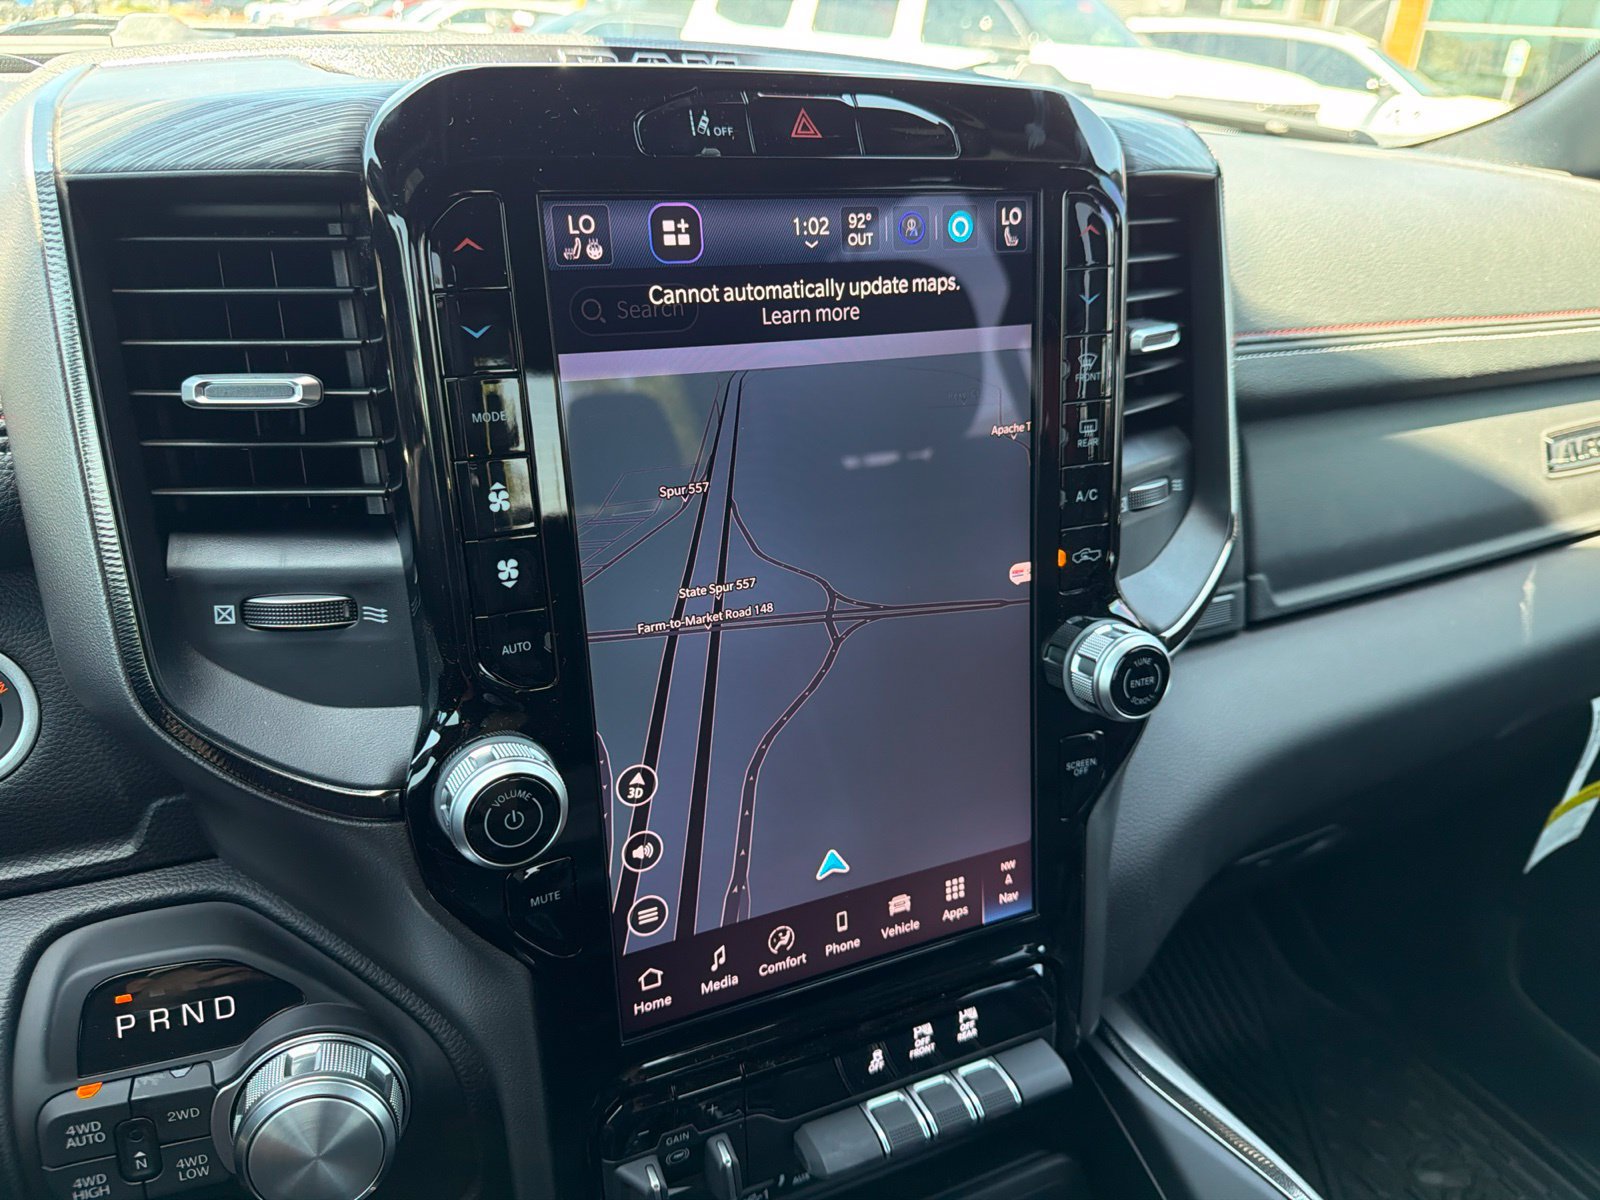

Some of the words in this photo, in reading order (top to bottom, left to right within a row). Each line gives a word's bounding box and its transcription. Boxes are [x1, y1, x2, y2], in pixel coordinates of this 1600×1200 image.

[713, 126, 734, 137] OFF
[567, 214, 595, 234] LO
[848, 212, 872, 229] 92°
[1001, 206, 1023, 226] LO
[793, 216, 830, 236] 1:02
[848, 232, 874, 246] OUT
[648, 284, 720, 305] Cannot
[723, 278, 845, 302] automatically
[849, 276, 909, 299] update
[912, 275, 961, 295] maps.
[617, 300, 684, 320] Search
[762, 307, 811, 325] Learn
[815, 305, 861, 322] more
[471, 411, 508, 423] MODE
[991, 423, 1025, 437] Apache
[1077, 437, 1099, 448] REAR
[659, 484, 687, 499] Spur
[688, 481, 710, 494] 557
[1075, 489, 1098, 502] A/C
[678, 587, 707, 599] State
[709, 582, 734, 596] Spur
[736, 577, 757, 590] 557
[637, 612, 724, 635] Farm-to-Market
[725, 605, 752, 621] Road
[754, 602, 774, 615] 148
[501, 641, 532, 656] AUTO
[1129, 676, 1155, 689] ENTER
[1066, 757, 1097, 771] SCREEN
[1073, 766, 1088, 777] OFF
[491, 789, 532, 809] VOLUME
[627, 787, 644, 799] 3D
[1000, 859, 1016, 872] NW
[530, 890, 561, 908] MUTE
[998, 891, 1019, 904] Nav
[942, 905, 969, 922] Apps
[881, 919, 920, 939] Vehicle
[825, 937, 861, 957] Phone
[758, 953, 807, 977] Comfort
[700, 974, 739, 995] Media
[633, 996, 672, 1016] Home
[115, 1013, 136, 1038] P
[149, 1008, 170, 1032] R
[181, 1000, 205, 1026] N
[214, 995, 236, 1020] D
[167, 1107, 200, 1122] 2WD
[65, 1120, 102, 1137] 4WD
[65, 1131, 106, 1149] AUTO
[665, 1131, 690, 1146] GAIN
[135, 1158, 148, 1170] N
[175, 1154, 208, 1169] 4WD
[72, 1173, 107, 1188] 4WD
[178, 1165, 210, 1182] LOW
[72, 1184, 111, 1200] HIGH
